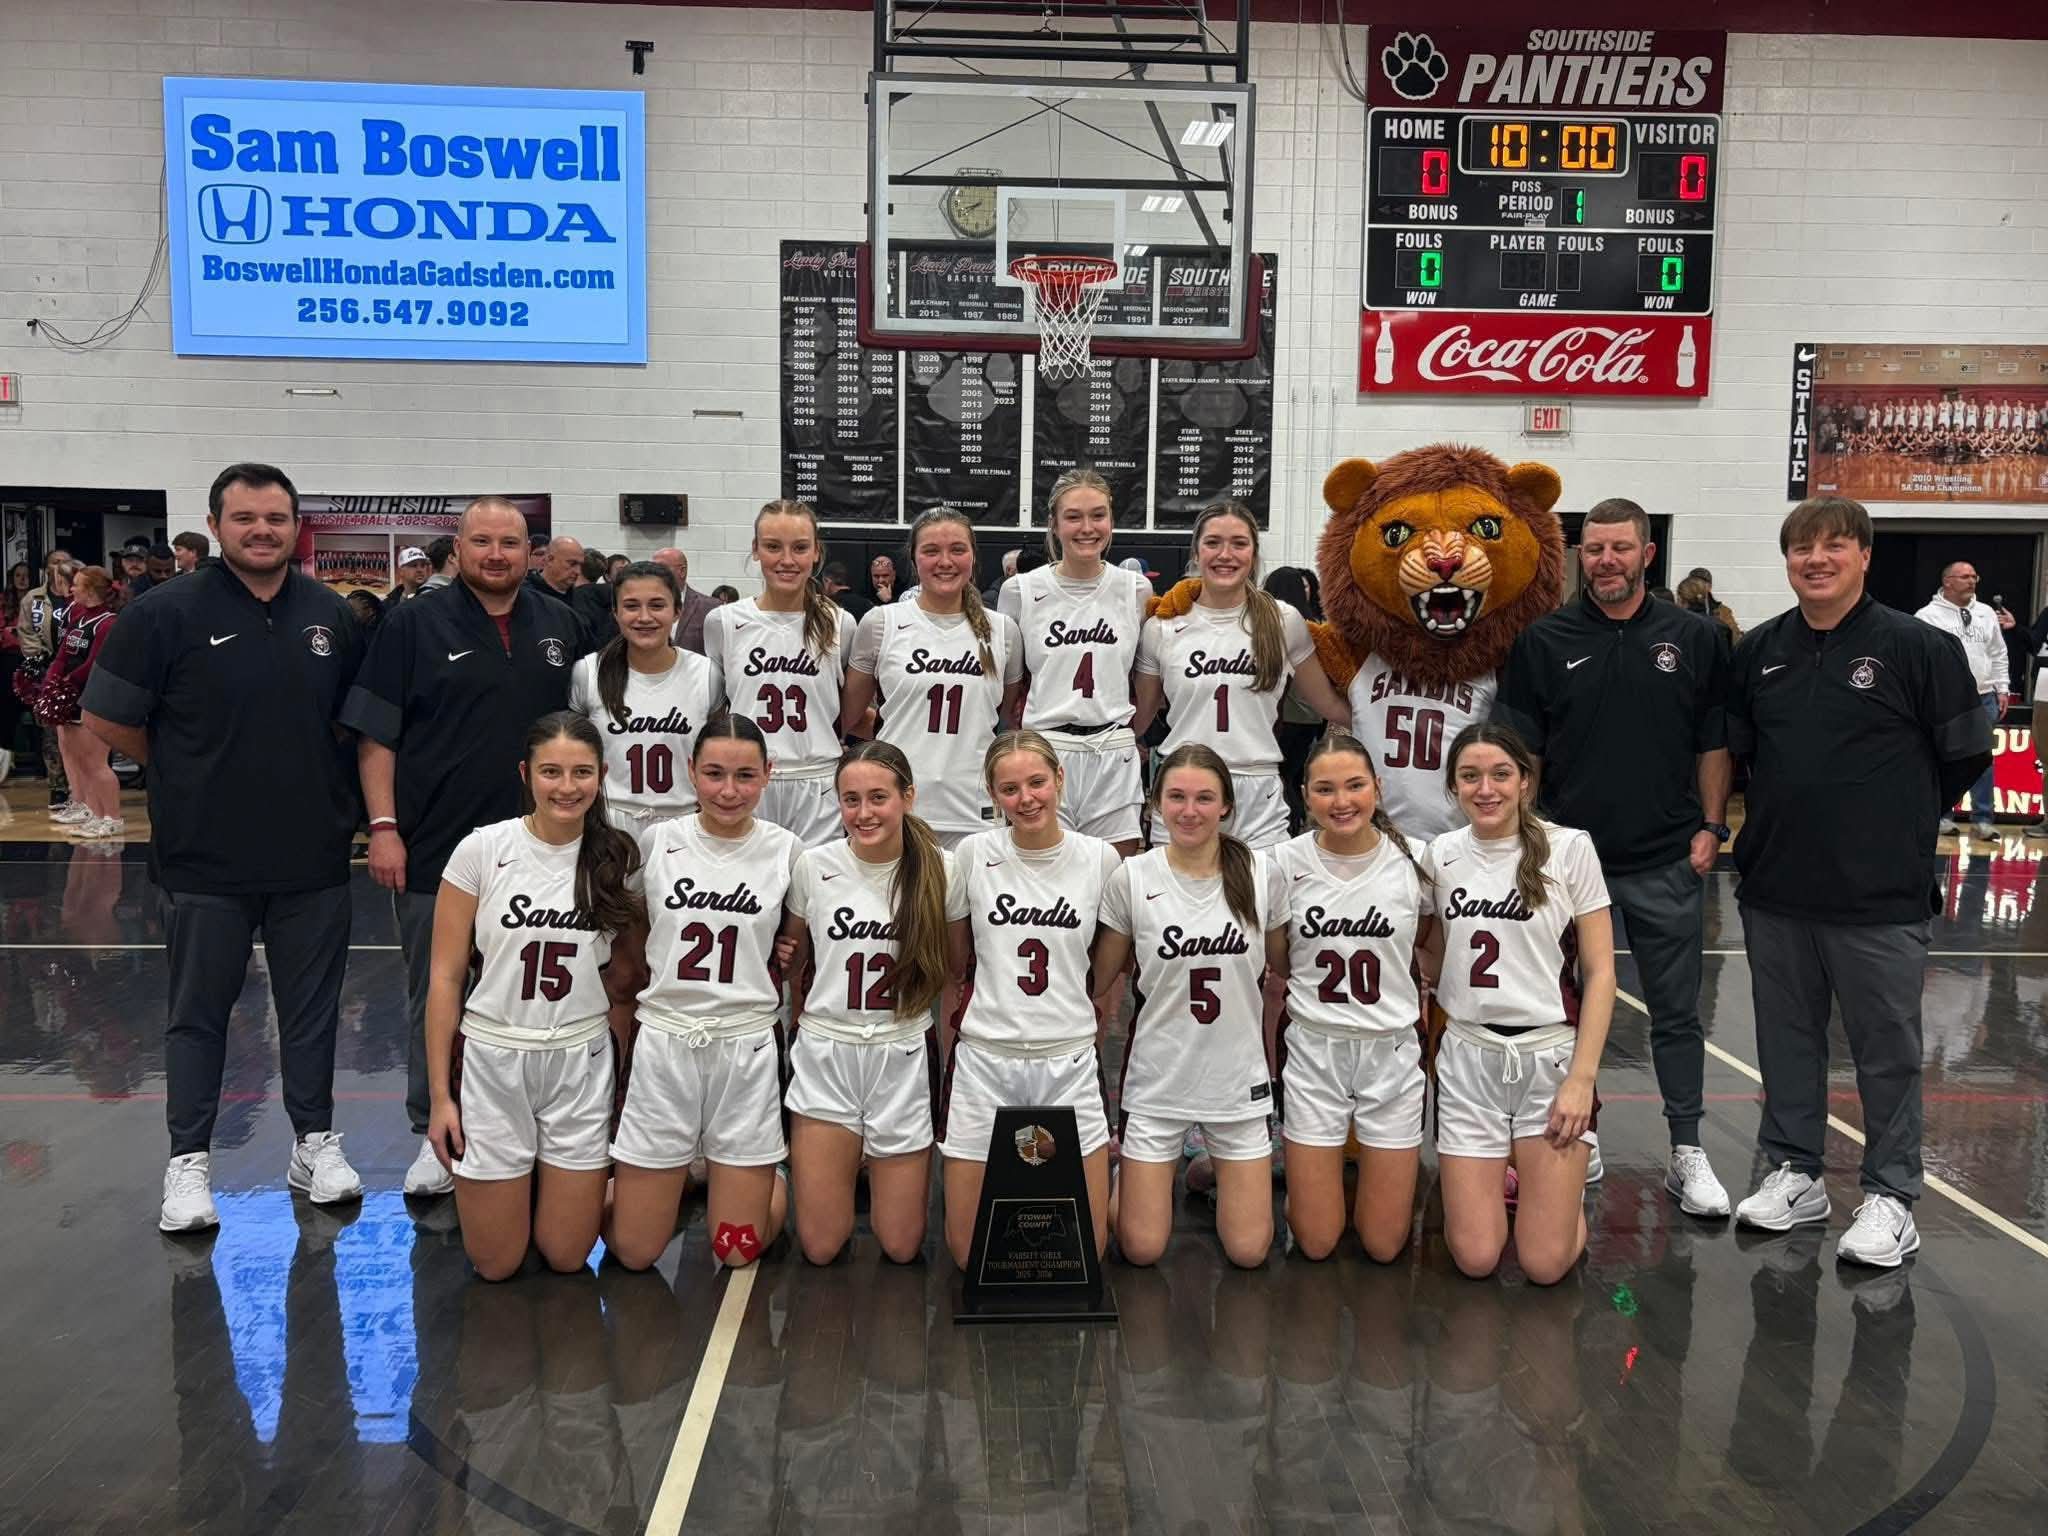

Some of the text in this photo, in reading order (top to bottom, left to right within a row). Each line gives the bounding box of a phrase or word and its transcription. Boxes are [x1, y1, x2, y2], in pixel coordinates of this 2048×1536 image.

[1527, 29, 1654, 52] SOUTHSIDE
[1457, 53, 1713, 106] PANTHERS
[190, 112, 621, 181] Sam Boswell
[1384, 118, 1715, 146] HOME VISITOR
[1490, 123, 1616, 170] 10:00
[1421, 149, 1449, 194] 0
[1512, 180, 1541, 193] POSS
[1679, 154, 1707, 200] 0
[280, 194, 617, 244] HONDA
[1408, 204, 1458, 220] BONUS
[1498, 194, 1554, 211] PERIOD
[1625, 209, 1675, 225] BONUS
[1395, 232, 1443, 248] FOULS
[1490, 235, 1604, 252] PLAYER FOULS
[1637, 237, 1684, 253] FOULS
[202, 254, 615, 291] BoswellHondaGadsden.com
[784, 250, 826, 271] Lady
[1420, 252, 1441, 286] 0
[1661, 256, 1683, 291] 0
[297, 297, 529, 328] 256.547.9092
[1405, 291, 1437, 305] WON
[1519, 293, 1557, 308] GAME
[1643, 296, 1674, 310] WON
[1417, 325, 1655, 384] Coca-Cola
[1534, 408, 1561, 429] EXIT
[1791, 368, 1812, 482] STATE
[311, 514, 459, 527] BASKETBALL 2025-202
[328, 496, 453, 514] SOUTHSIDE
[1045, 618, 1118, 647] Sardis
[743, 647, 820, 676] Sardis
[905, 648, 984, 676] Sardis
[1072, 651, 1095, 699] 4
[607, 706, 693, 735] Sardis
[756, 683, 807, 734] 33
[926, 683, 964, 735] 11
[1213, 684, 1228, 733] 1
[1384, 705, 1445, 771] 50
[626, 744, 674, 794] 10
[664, 877, 762, 915] Sardis
[987, 893, 1081, 929] Sardis
[1445, 887, 1534, 921] Sardis
[1300, 905, 1395, 939] Sardis
[677, 921, 738, 984] 21
[1157, 922, 1249, 960] Sardis
[519, 940, 578, 1002] 15
[1017, 938, 1050, 997] 3
[1315, 948, 1381, 1005] 20
[1469, 930, 1500, 989] 2
[845, 951, 898, 1010] 12
[1189, 967, 1221, 1025] 5
